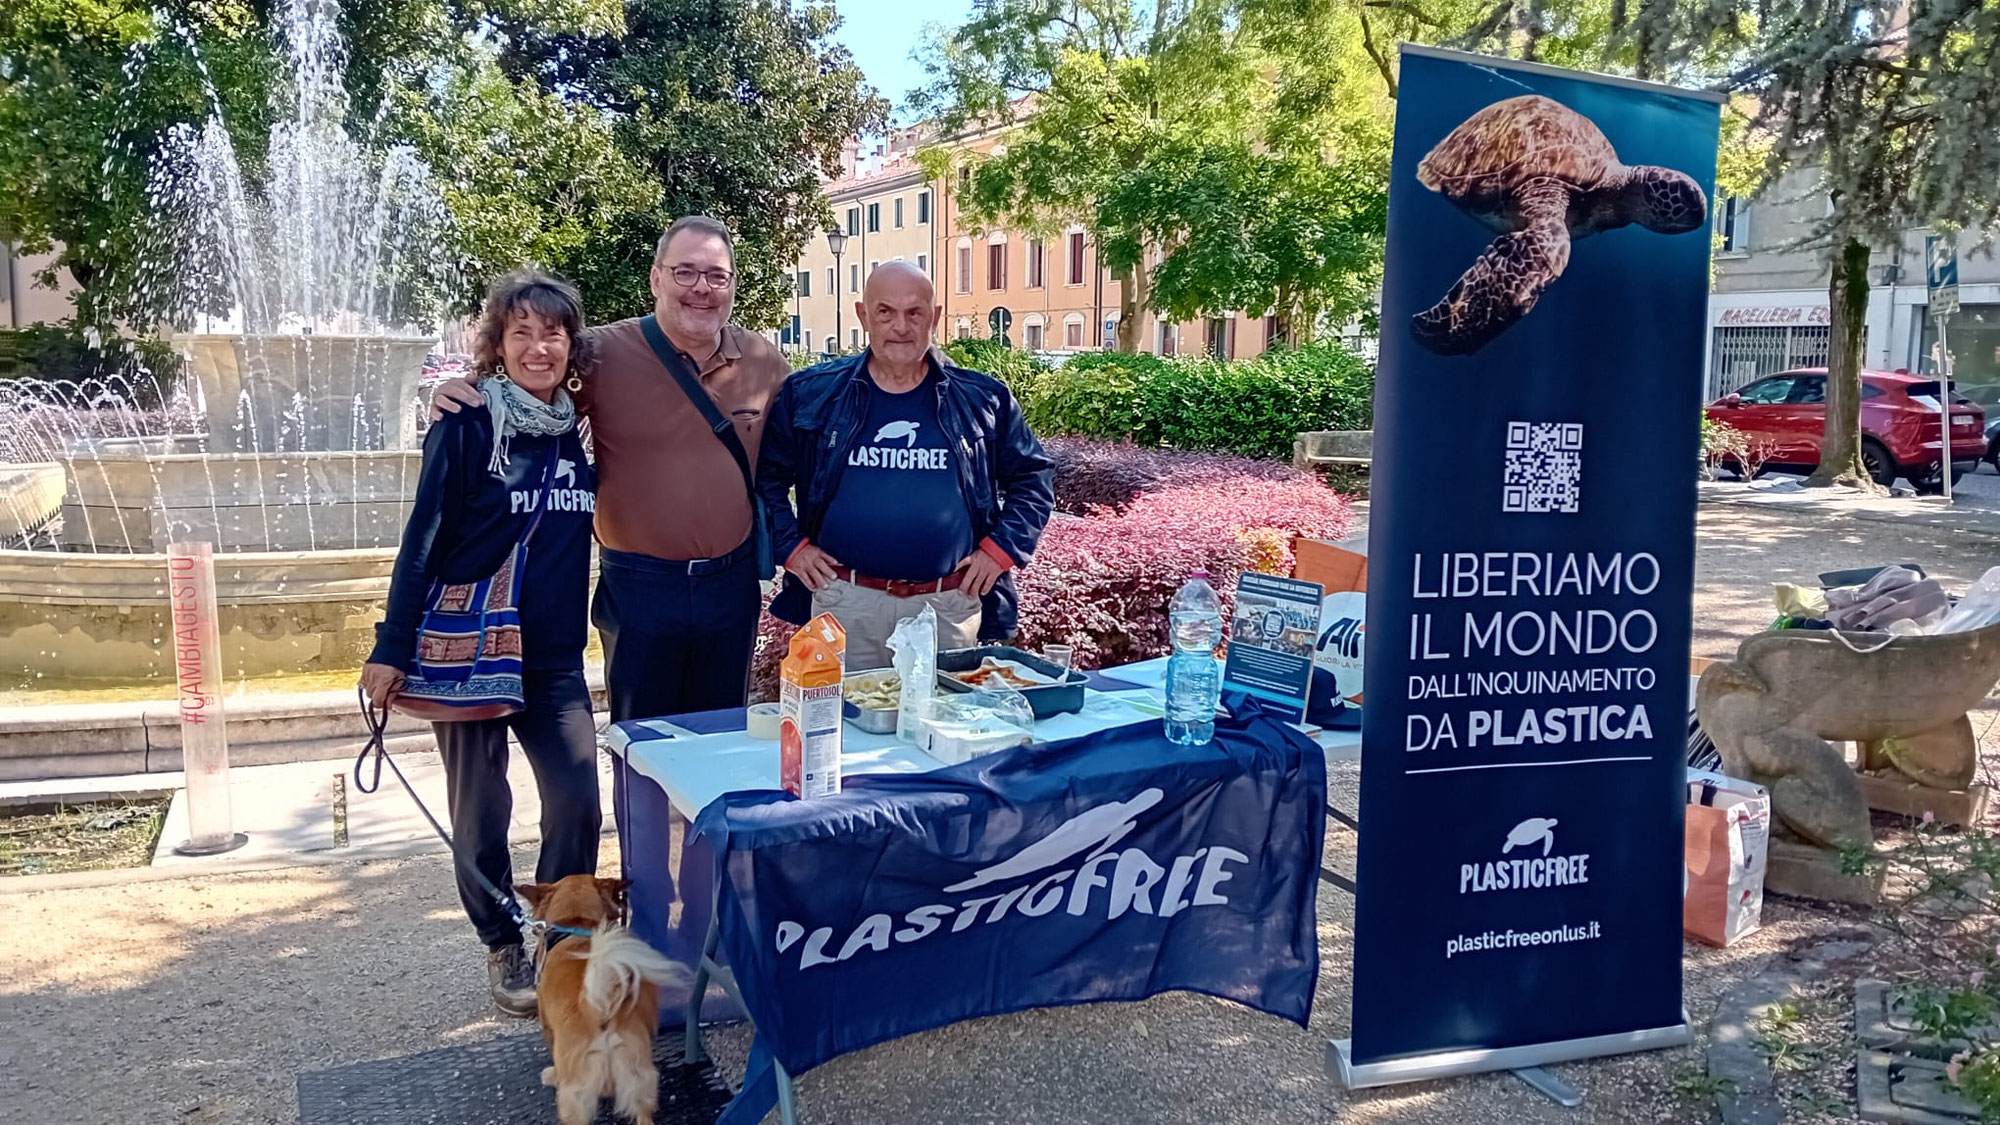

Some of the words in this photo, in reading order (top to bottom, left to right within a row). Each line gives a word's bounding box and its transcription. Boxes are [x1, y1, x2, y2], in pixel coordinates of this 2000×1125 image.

[1719, 307, 1802, 324] MACELLERIA
[848, 446, 949, 470] LASTICFREE
[511, 488, 595, 514] PLATICFRE
[1413, 552, 1661, 598] LIBERIAMO
[170, 557, 206, 726] #CAMBIAGESTO
[1410, 613, 1450, 660] IL
[1463, 608, 1658, 658] MONDO
[803, 684, 840, 701] PUERTOSOL
[1408, 667, 1656, 700] DALL'INQUINAMENTO
[1405, 713, 1458, 752] DA
[1468, 704, 1653, 748] PLASTICA
[1460, 854, 1590, 894] PLASTICFREE
[776, 846, 1249, 971] PLASTICFREE
[1446, 921, 1601, 959] plasticfreeonlus.it
